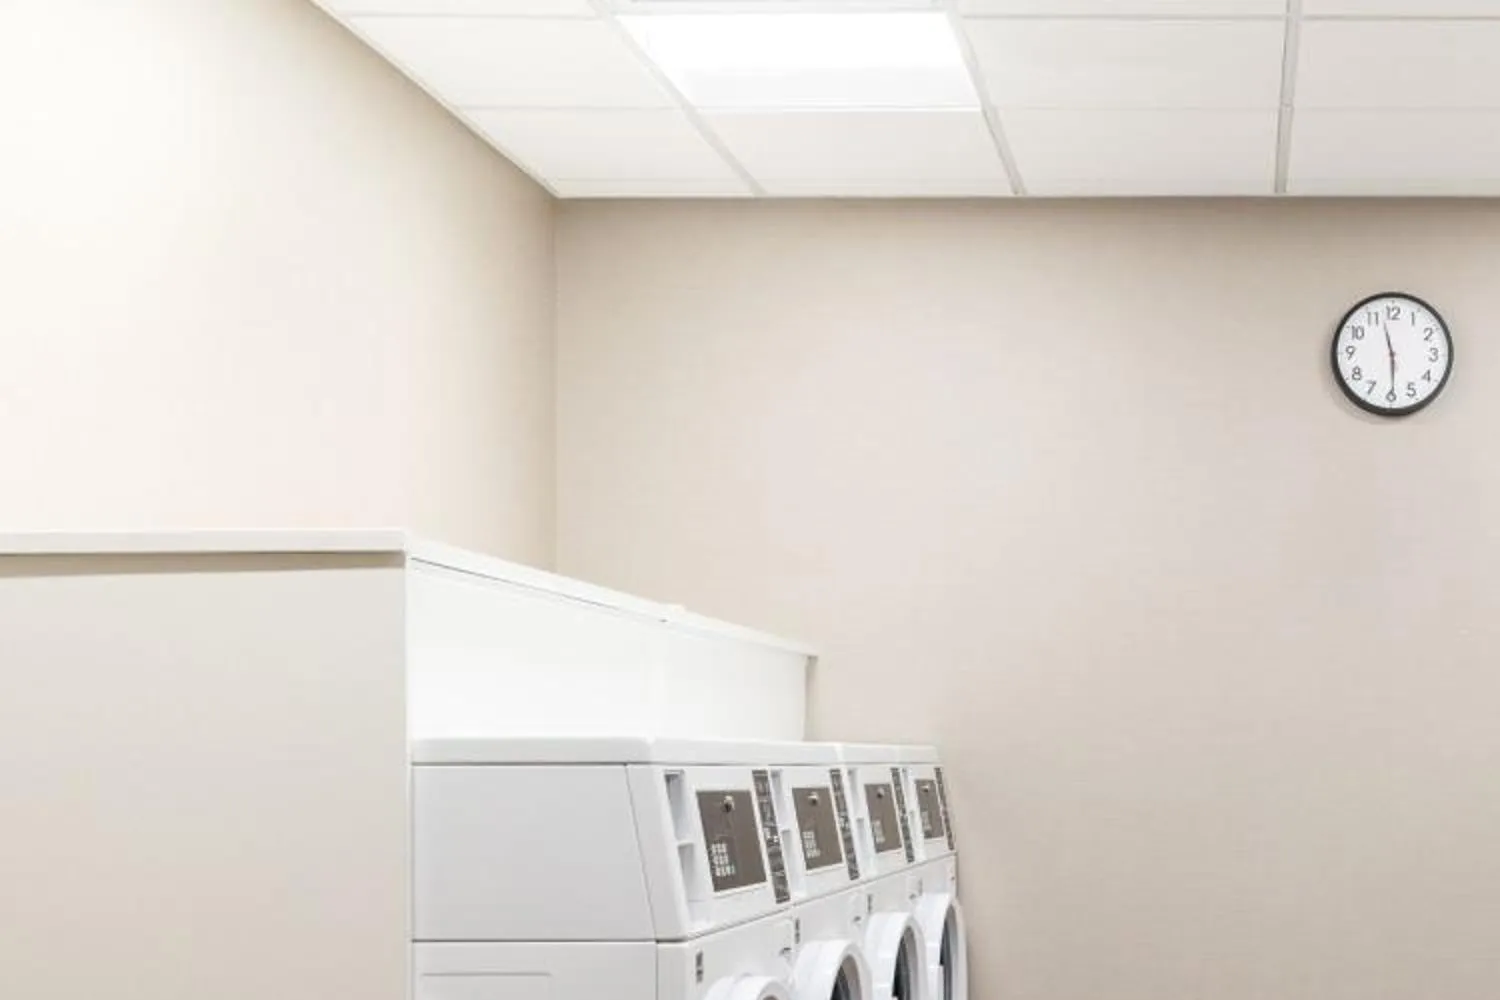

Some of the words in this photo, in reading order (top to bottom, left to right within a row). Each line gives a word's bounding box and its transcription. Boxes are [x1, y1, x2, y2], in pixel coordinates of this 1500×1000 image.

[1367, 311, 1379, 326] 11
[1386, 305, 1401, 321] 12
[1411, 311, 1415, 326] 1
[1351, 325, 1365, 340] 10
[1423, 327, 1434, 342] 2
[1345, 345, 1356, 360] 9
[1428, 347, 1439, 362] 3
[1351, 366, 1362, 381] 8
[1421, 369, 1431, 383] 4
[1366, 380, 1377, 395] 7
[1385, 387, 1397, 403] 6
[1406, 382, 1417, 398] 5
